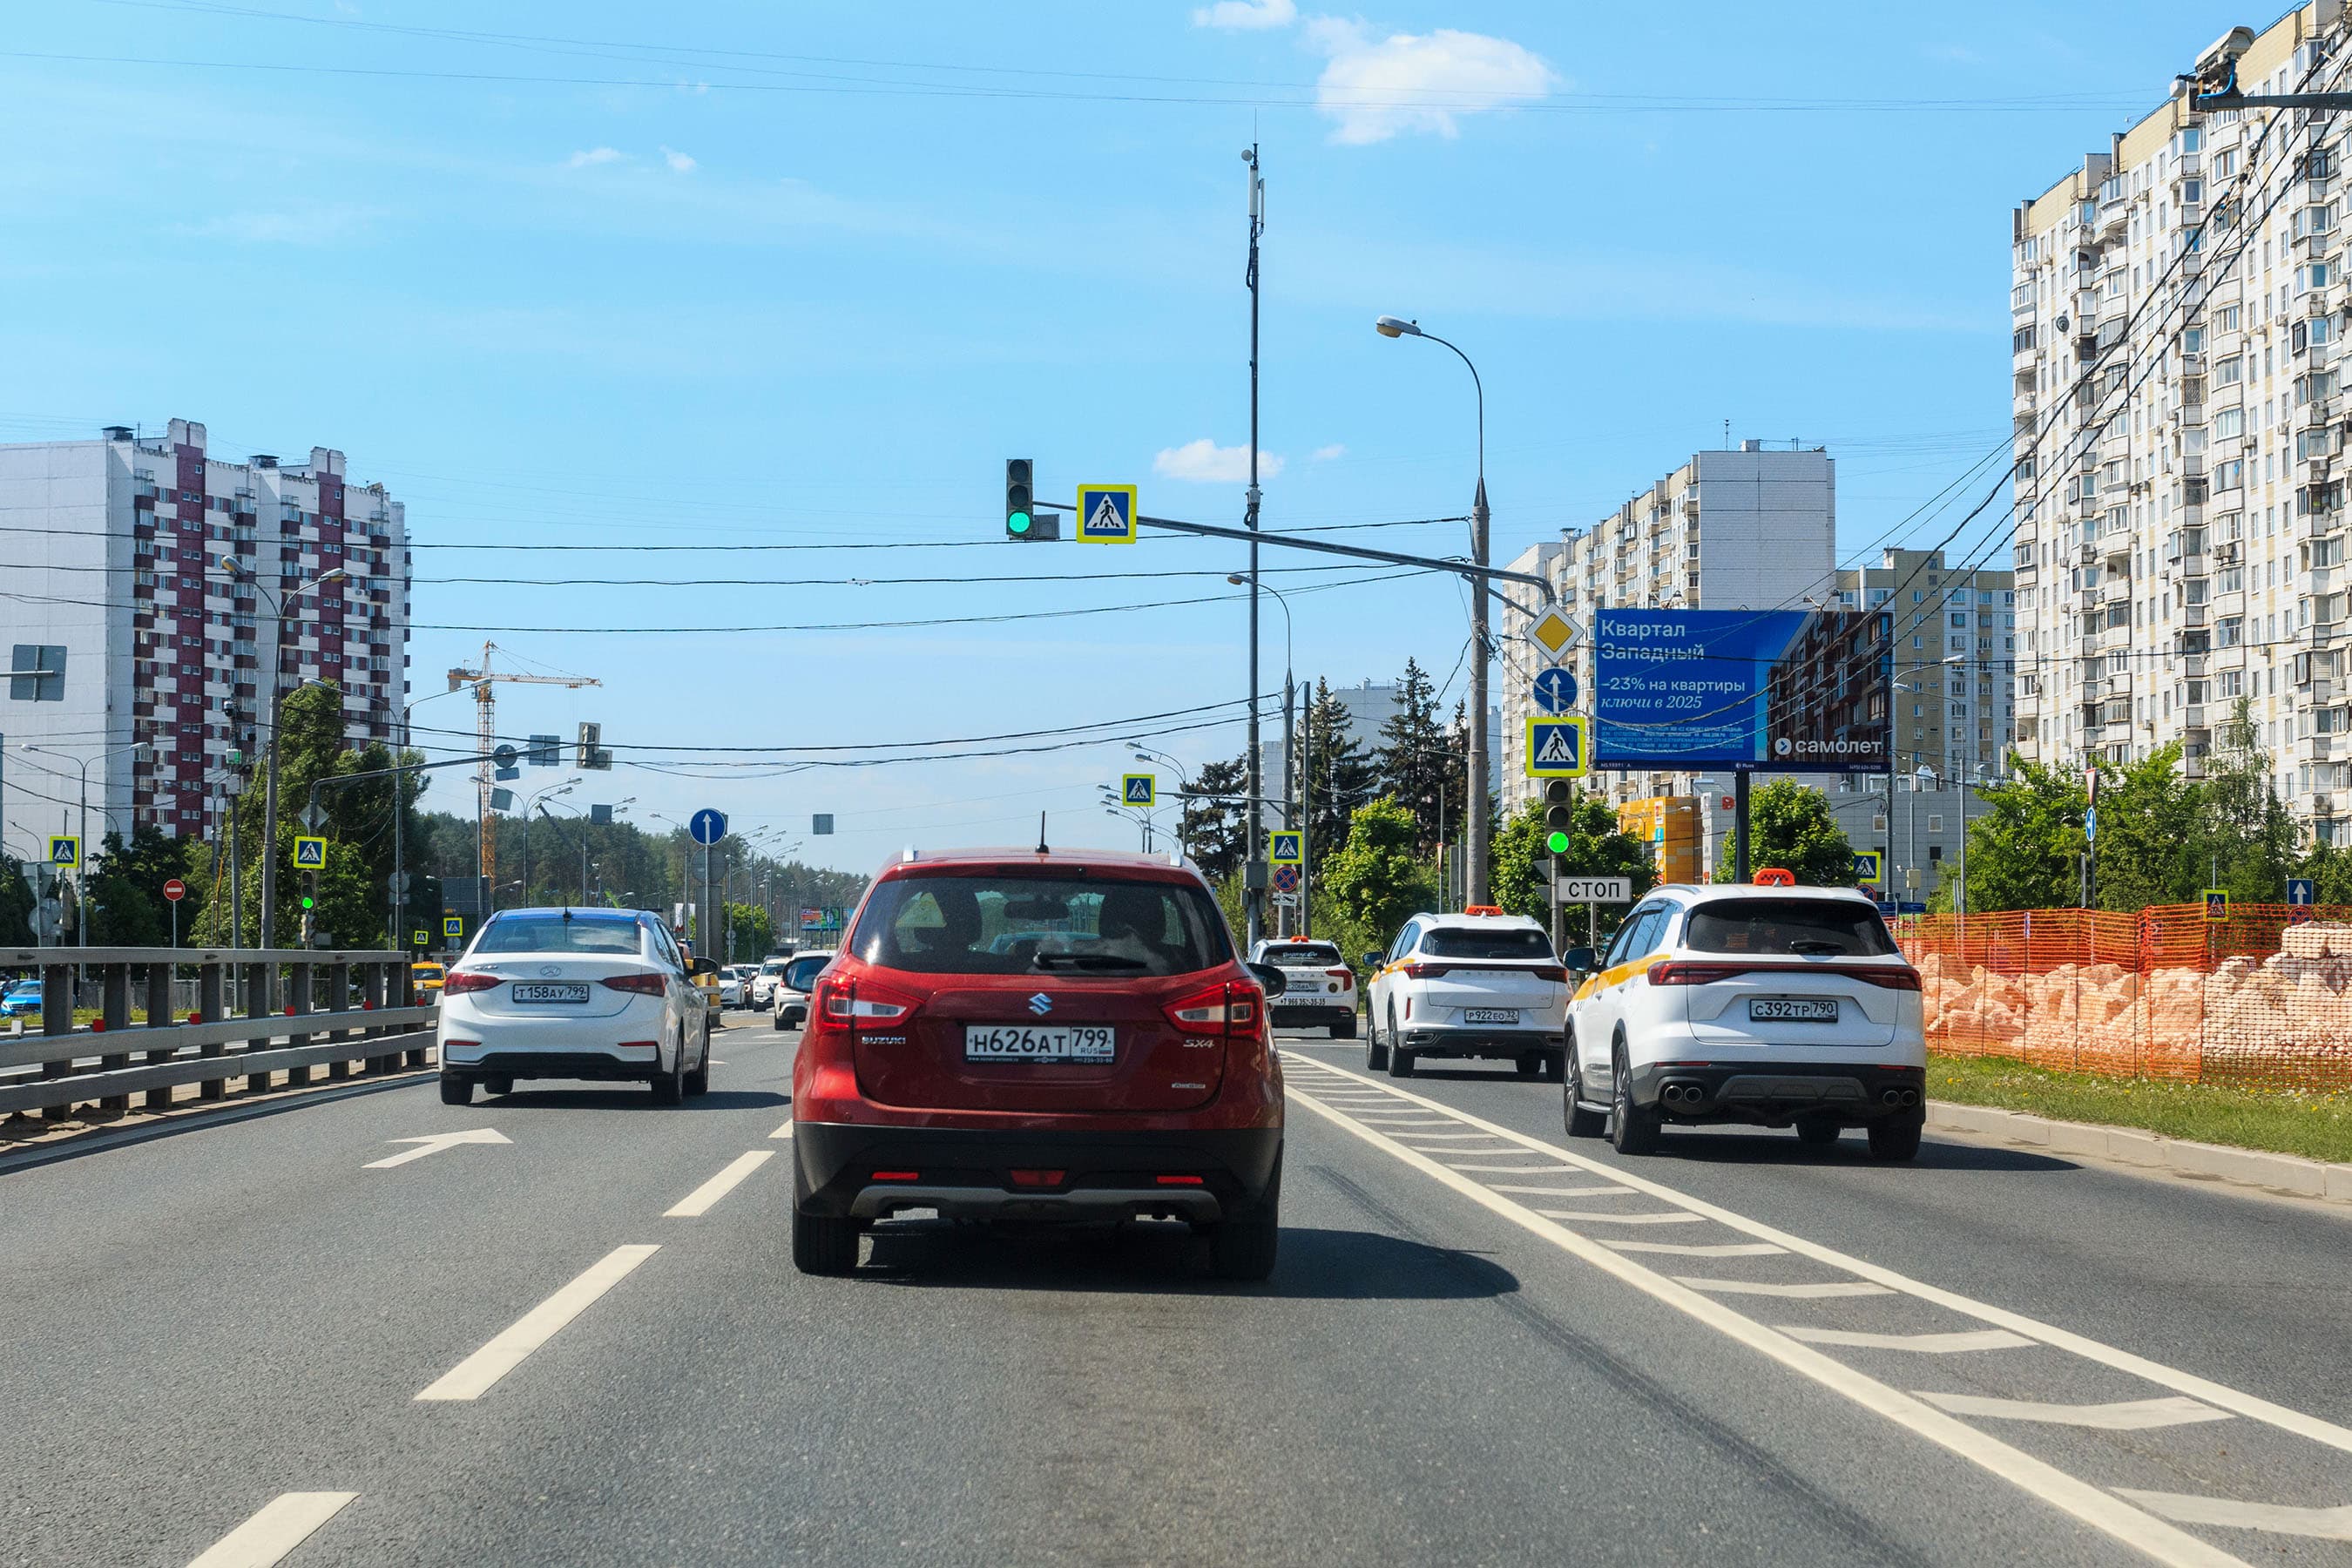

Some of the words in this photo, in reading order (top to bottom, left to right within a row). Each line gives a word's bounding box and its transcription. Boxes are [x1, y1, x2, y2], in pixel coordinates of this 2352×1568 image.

[1601, 619, 1686, 641] Квартал
[1601, 642, 1705, 662] Западный
[1649, 681, 1667, 691] на
[1671, 680, 1746, 694] квартиры
[1601, 697, 1652, 708] ключи
[1654, 697, 1663, 708] в
[1666, 695, 1703, 709] 2025
[1794, 740, 1882, 754] самолет
[1568, 882, 1620, 898] СТОП
[518, 986, 564, 998] Т158АУ
[567, 986, 585, 996] 799
[1469, 1010, 1505, 1020] Р922ЕО
[1755, 1002, 1810, 1017] С392ТР
[1812, 1002, 1834, 1013] 790
[862, 1036, 907, 1045] SUZUKI
[974, 1030, 1066, 1053] Н626АТ
[1072, 1029, 1108, 1047] 799
[1183, 1039, 1214, 1048] SX4
